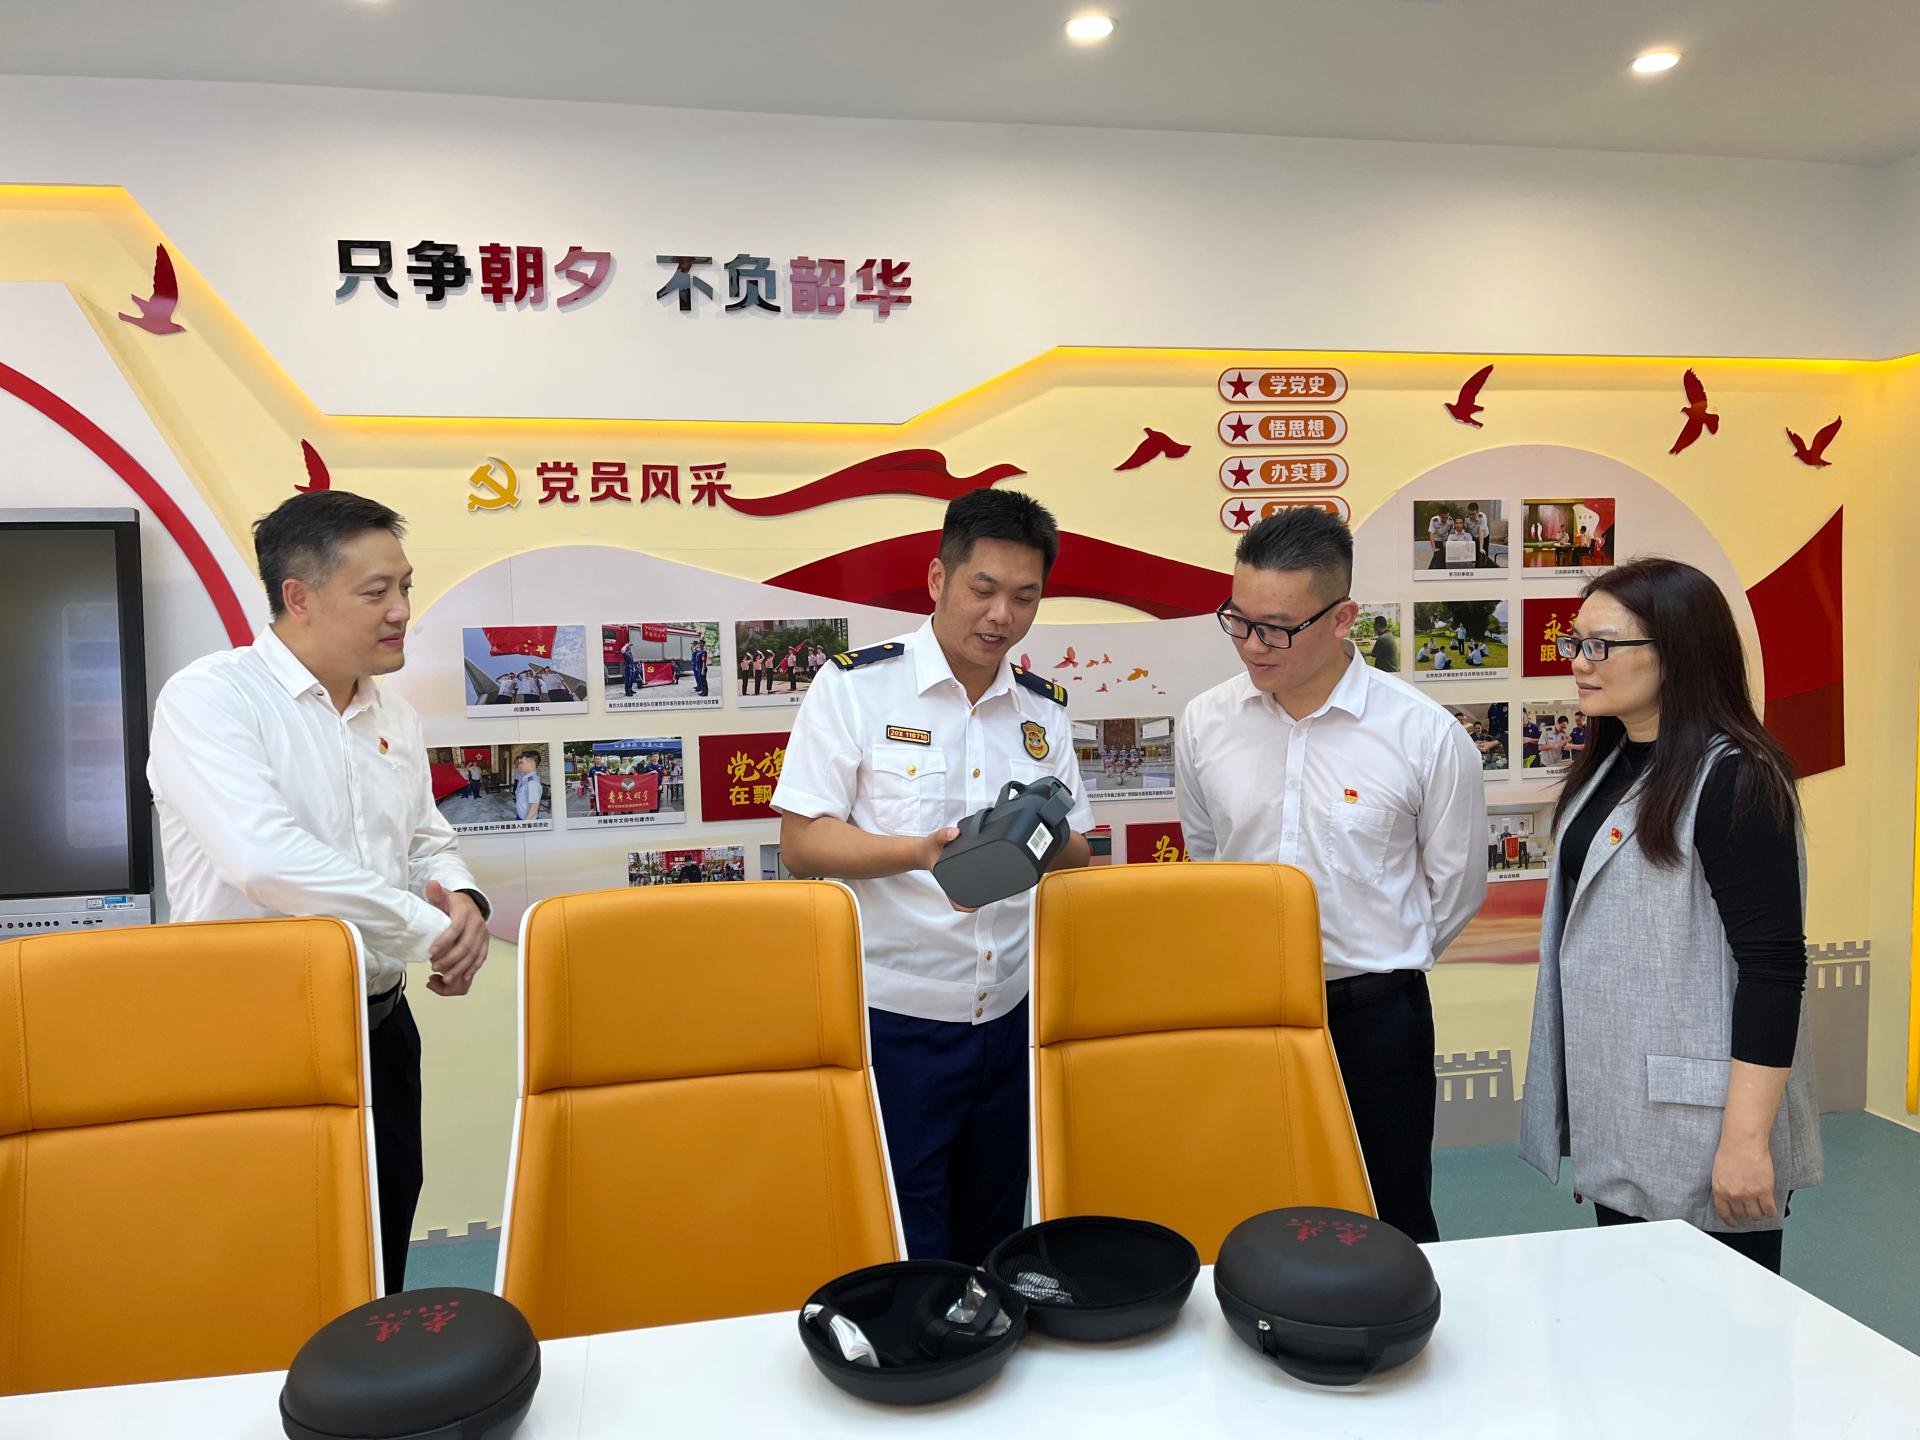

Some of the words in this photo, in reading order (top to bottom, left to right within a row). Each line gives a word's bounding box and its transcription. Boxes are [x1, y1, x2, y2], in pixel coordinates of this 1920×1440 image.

[336, 240, 612, 308] 只争朝夕
[656, 253, 912, 316] 不负韶华
[1269, 375, 1326, 395] 学党史
[1268, 419, 1325, 439] 悟思想
[1271, 463, 1327, 482] 办实事
[536, 460, 732, 508] 党员风采
[727, 747, 786, 783] 党旗
[729, 785, 772, 806] 在飘
